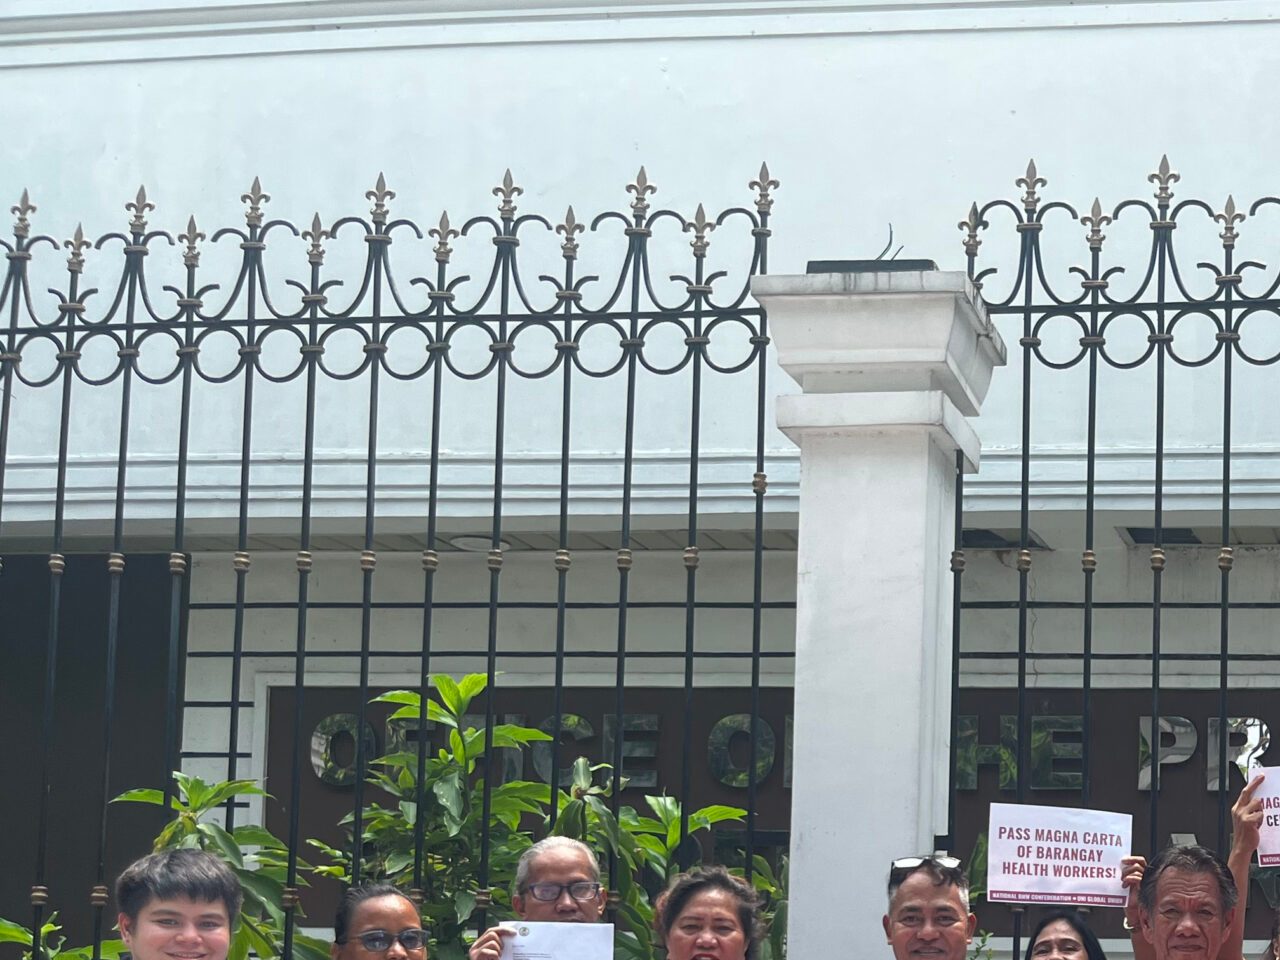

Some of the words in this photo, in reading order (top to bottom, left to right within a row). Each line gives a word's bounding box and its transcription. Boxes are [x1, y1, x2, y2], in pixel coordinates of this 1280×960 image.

[999, 827, 1030, 840] PASS
[1035, 829, 1078, 843] MAGNA
[1083, 832, 1123, 847] CARTA
[1017, 845, 1032, 858] OF
[1036, 846, 1103, 862] BARANGAY
[1002, 862, 1048, 876] HEALTH
[1053, 864, 1116, 879] WORKERS!
[992, 892, 1017, 900] NATIONAL
